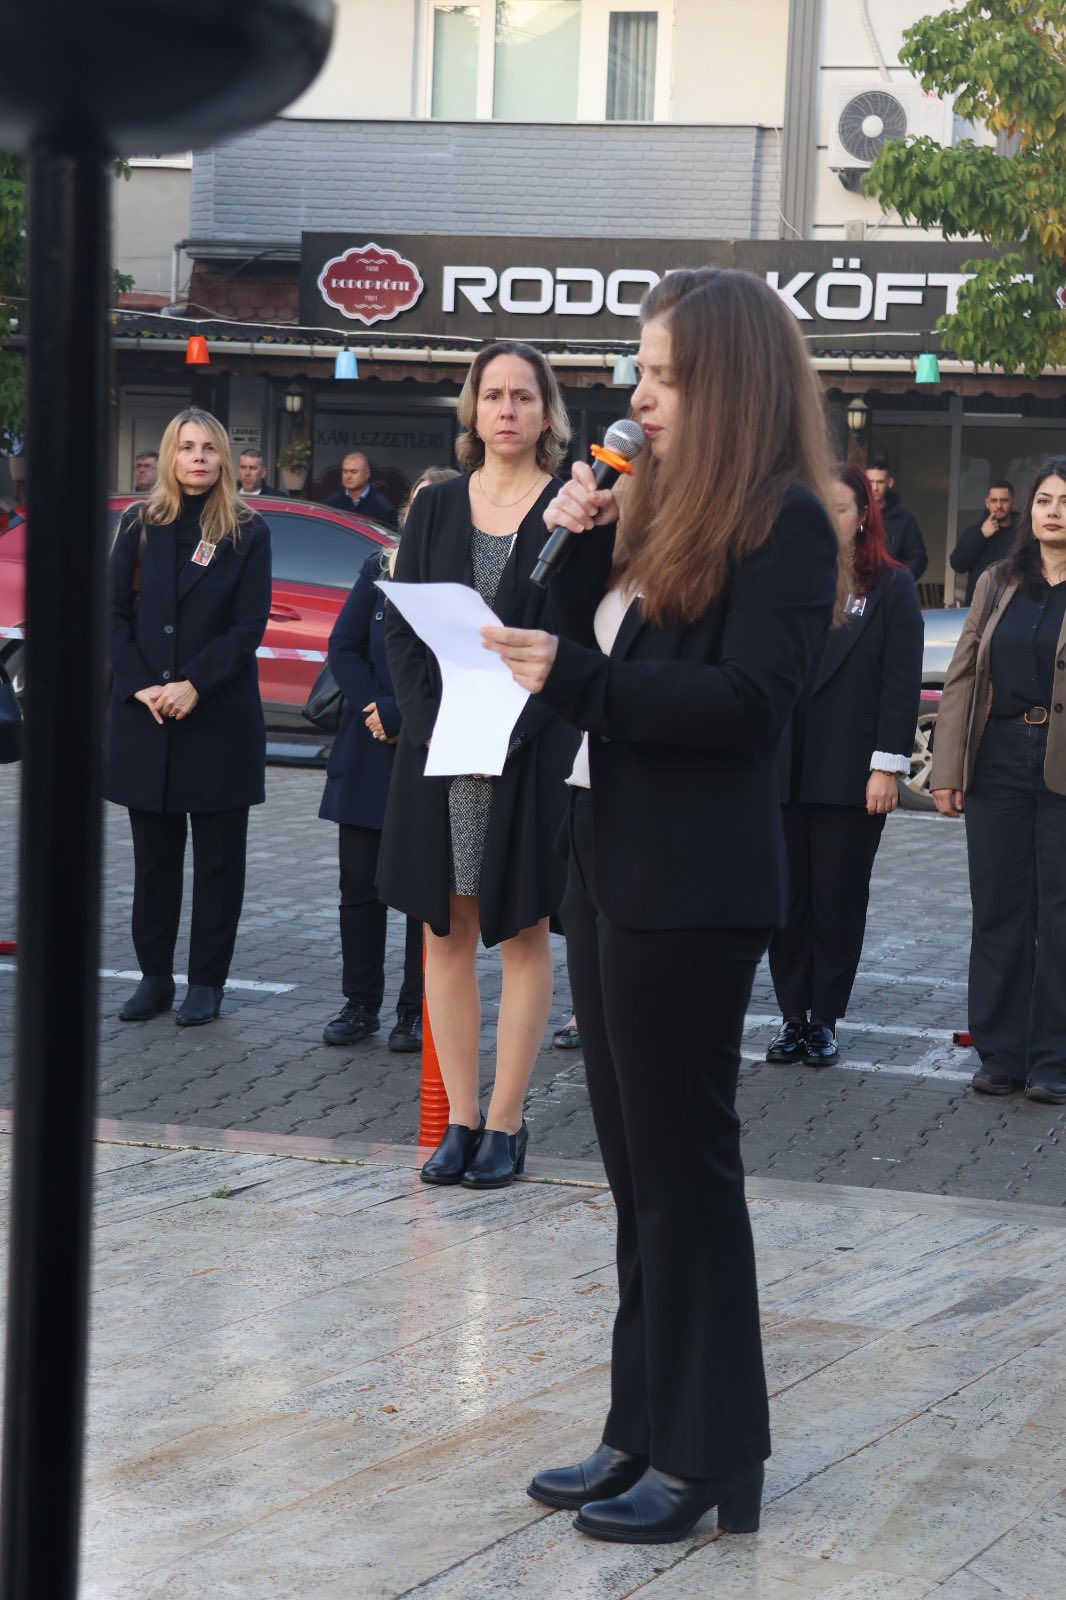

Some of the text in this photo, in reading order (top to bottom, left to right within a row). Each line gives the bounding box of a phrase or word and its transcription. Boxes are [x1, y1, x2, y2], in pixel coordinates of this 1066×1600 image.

[331, 278, 374, 290] RODOP
[442, 257, 1034, 322] RODO KÖFT
